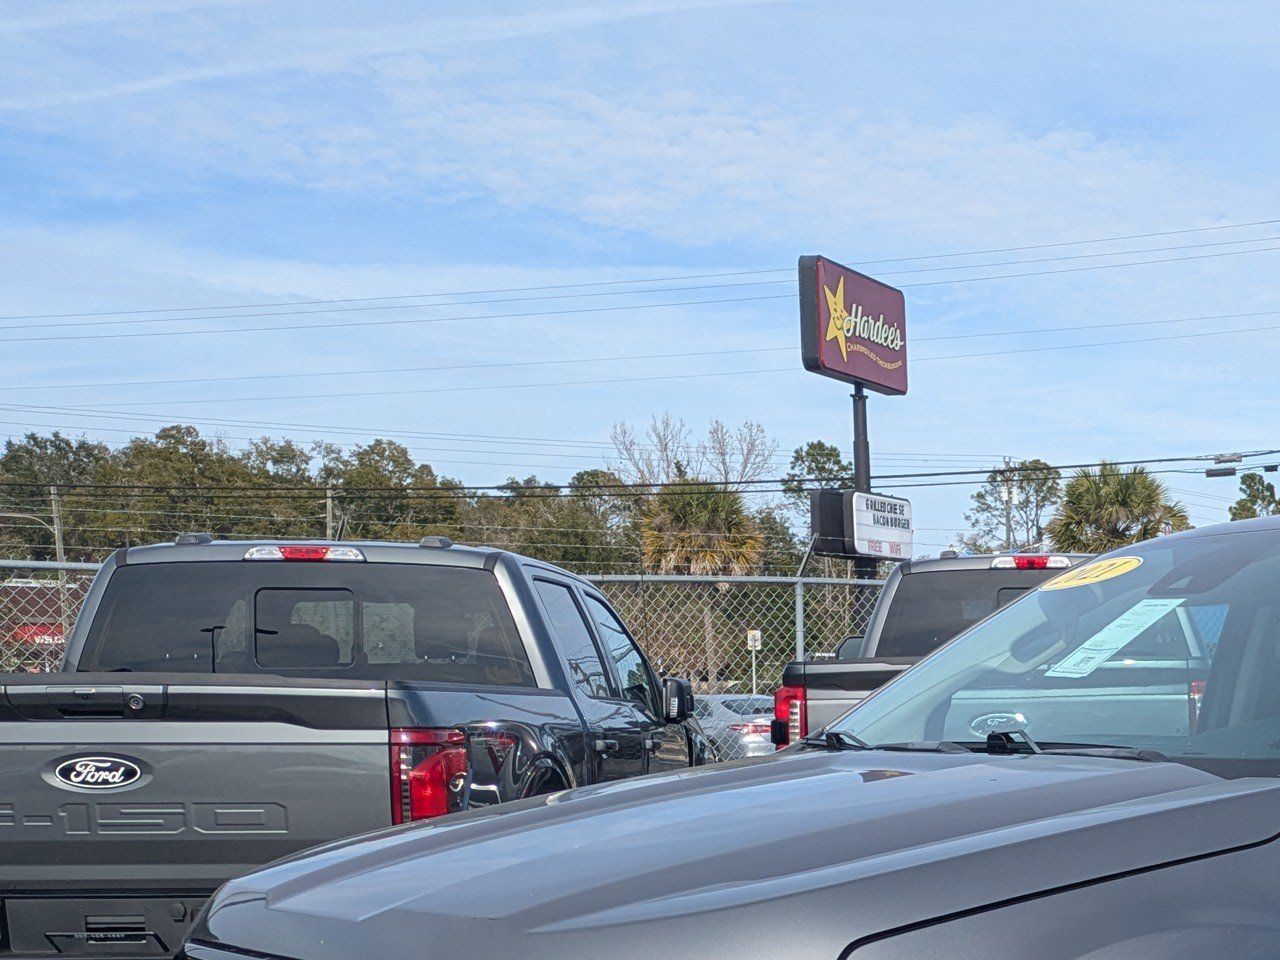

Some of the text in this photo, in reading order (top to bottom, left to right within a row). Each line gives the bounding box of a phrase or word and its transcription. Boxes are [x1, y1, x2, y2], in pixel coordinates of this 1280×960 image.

[843, 303, 904, 351] Hardee's
[873, 514, 911, 530] BACON BURGER
[70, 761, 125, 783] Ford
[0, 803, 288, 834] -150
